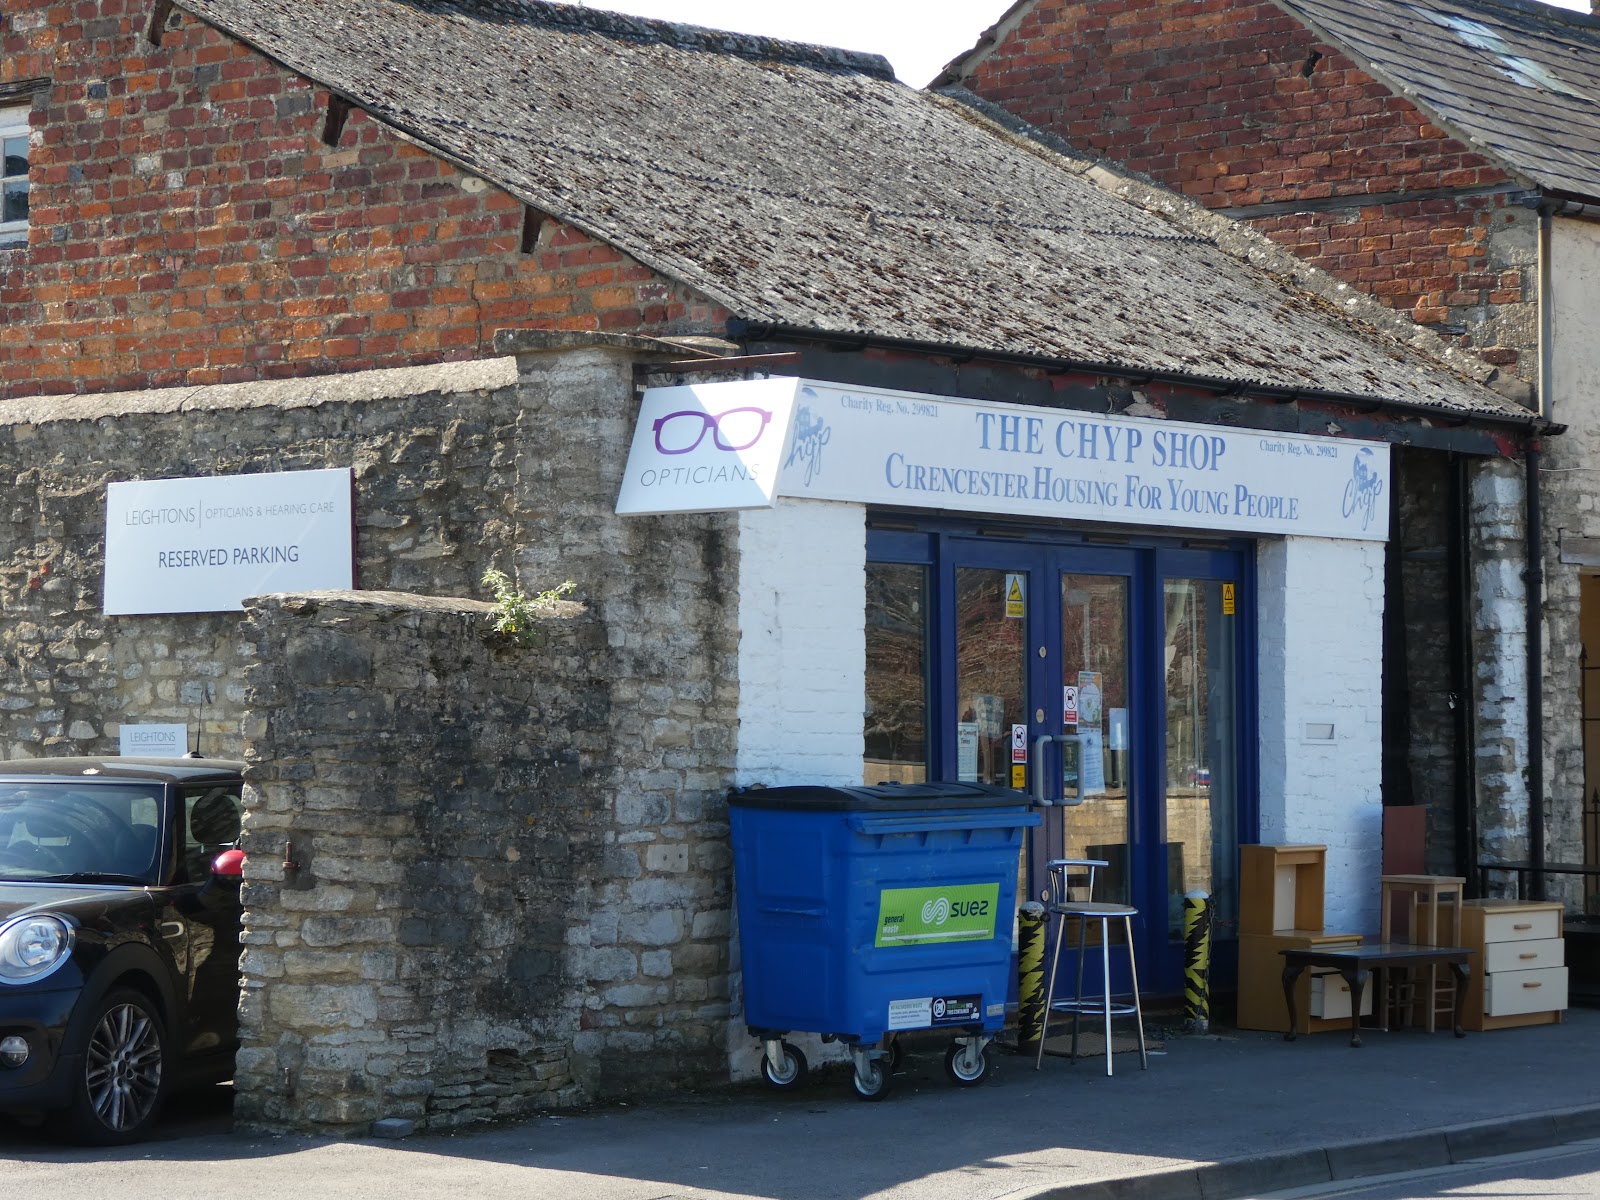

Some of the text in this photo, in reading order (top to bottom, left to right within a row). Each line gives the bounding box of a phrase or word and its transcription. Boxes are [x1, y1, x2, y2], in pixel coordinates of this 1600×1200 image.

[841, 395, 939, 418] Charity Reg. No. 299821
[975, 411, 1226, 471] THE CHYP SHOP
[1259, 439, 1338, 459] Charity Reg. No. 299821
[640, 463, 761, 488] OPTICIANS
[125, 502, 335, 526] LEIGHTONS OPTICIANS & HEARING CARE
[158, 545, 299, 569] RESERVED PARKING
[130, 731, 176, 743] LEIGHTONS
[950, 900, 989, 918] suez
[882, 924, 899, 934] waste
[884, 914, 905, 926] general
